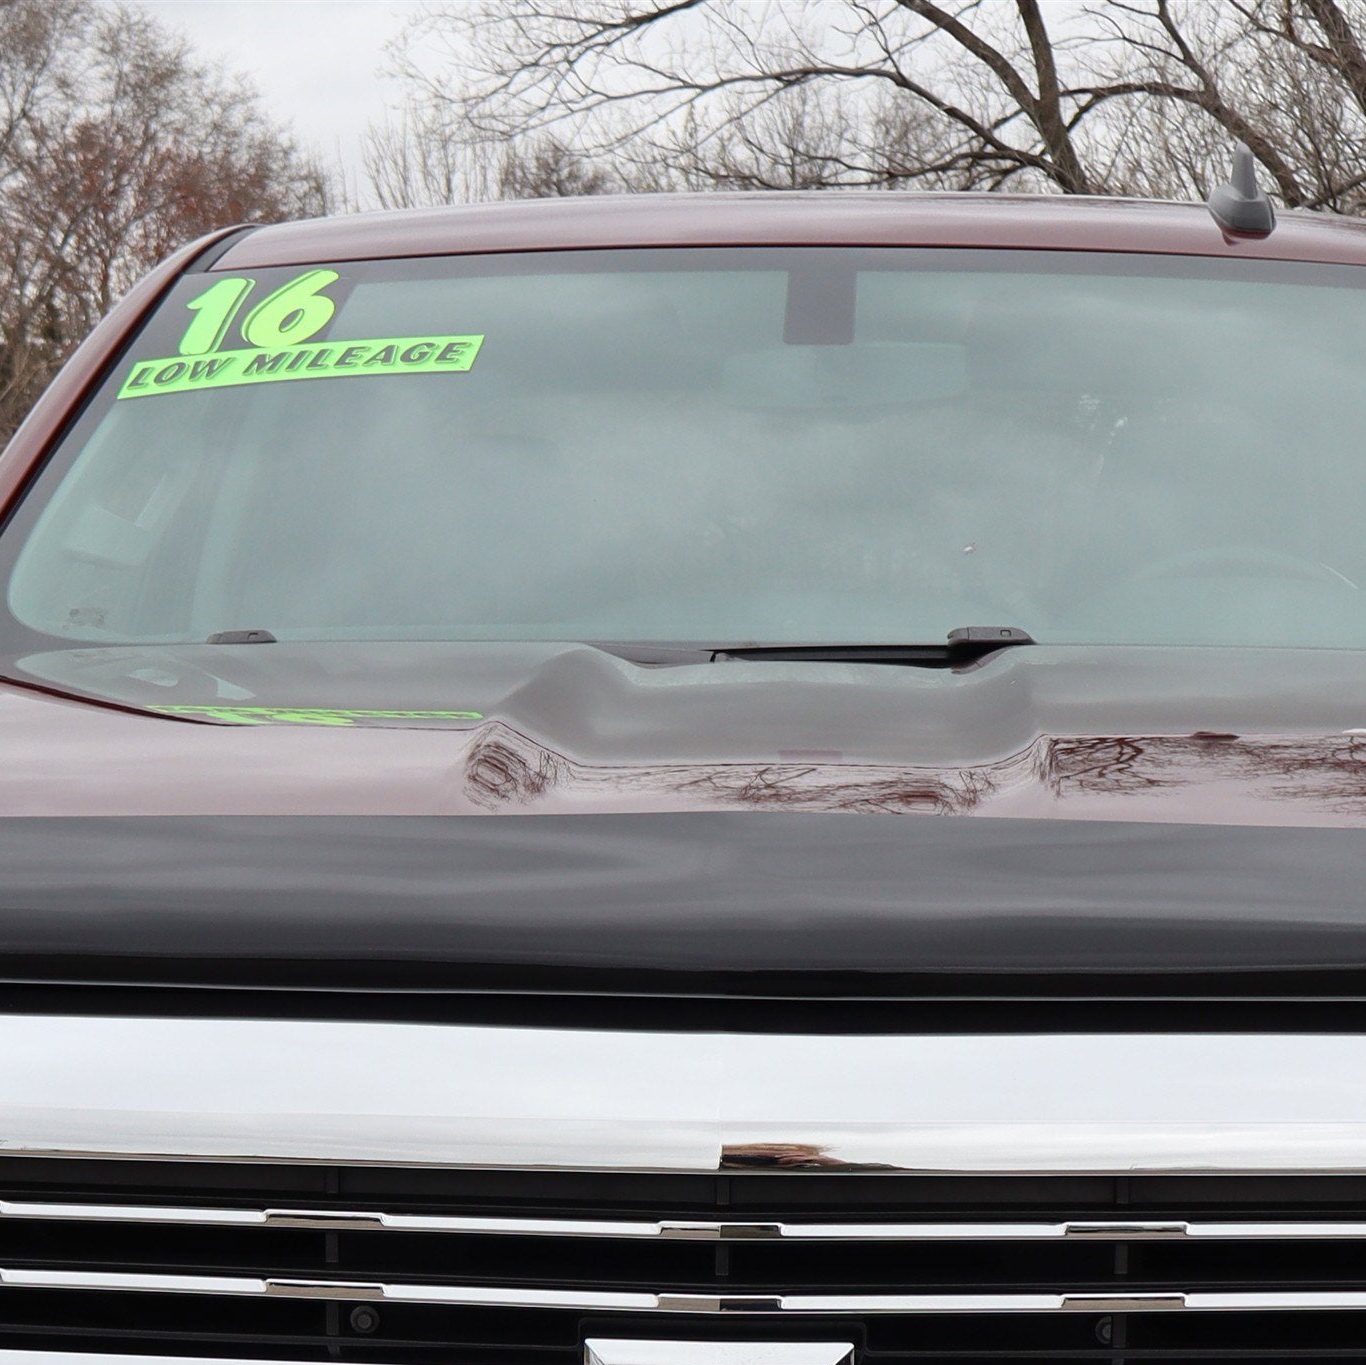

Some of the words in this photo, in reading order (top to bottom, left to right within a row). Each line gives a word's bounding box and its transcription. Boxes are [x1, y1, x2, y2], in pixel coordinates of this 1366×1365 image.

[177, 269, 339, 355] 16
[126, 357, 237, 389] LOW
[242, 342, 473, 376] MILEAGE
